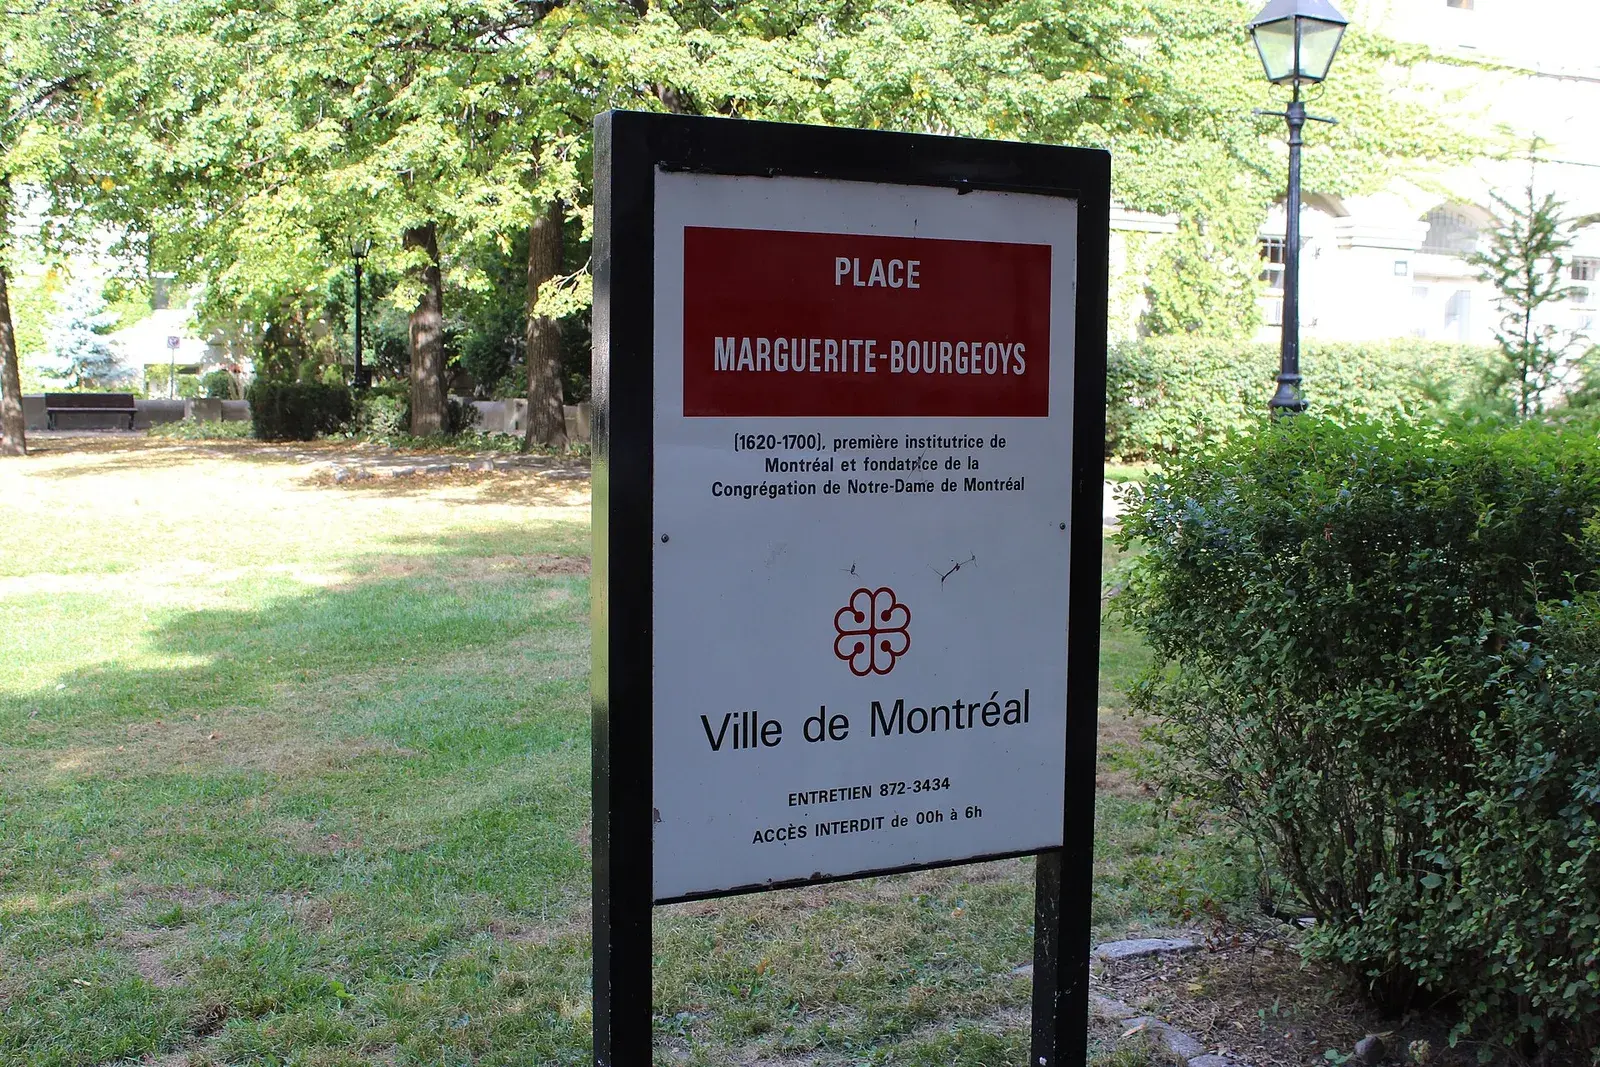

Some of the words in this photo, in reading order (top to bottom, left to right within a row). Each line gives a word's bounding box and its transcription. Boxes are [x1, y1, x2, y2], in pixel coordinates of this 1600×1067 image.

[835, 256, 921, 289] PLACE
[714, 336, 1026, 375] MARGUERITE-BOURGEOYS
[833, 434, 899, 453] première
[905, 433, 984, 449] institutrice
[989, 433, 1007, 449] de
[765, 456, 834, 473] Montréal
[840, 458, 857, 472] et
[863, 456, 939, 473] fondatrice
[944, 455, 962, 471] de
[967, 455, 979, 470] la
[711, 479, 817, 500] Congrégation
[822, 479, 841, 495] de
[847, 478, 935, 495] Notre-Dame
[940, 477, 958, 493] de
[963, 476, 1025, 492] Montréal
[699, 710, 783, 752] Ville
[803, 705, 850, 743] de
[870, 688, 1030, 738] Montréal
[788, 784, 872, 807] ENTRETIEN
[879, 776, 951, 797] 872-3434
[752, 823, 808, 844] ACCÈS
[815, 816, 885, 837] INTERDIT
[890, 814, 909, 828] de
[915, 809, 944, 825] 00h
[950, 807, 959, 821] à
[964, 805, 983, 819] 6h
